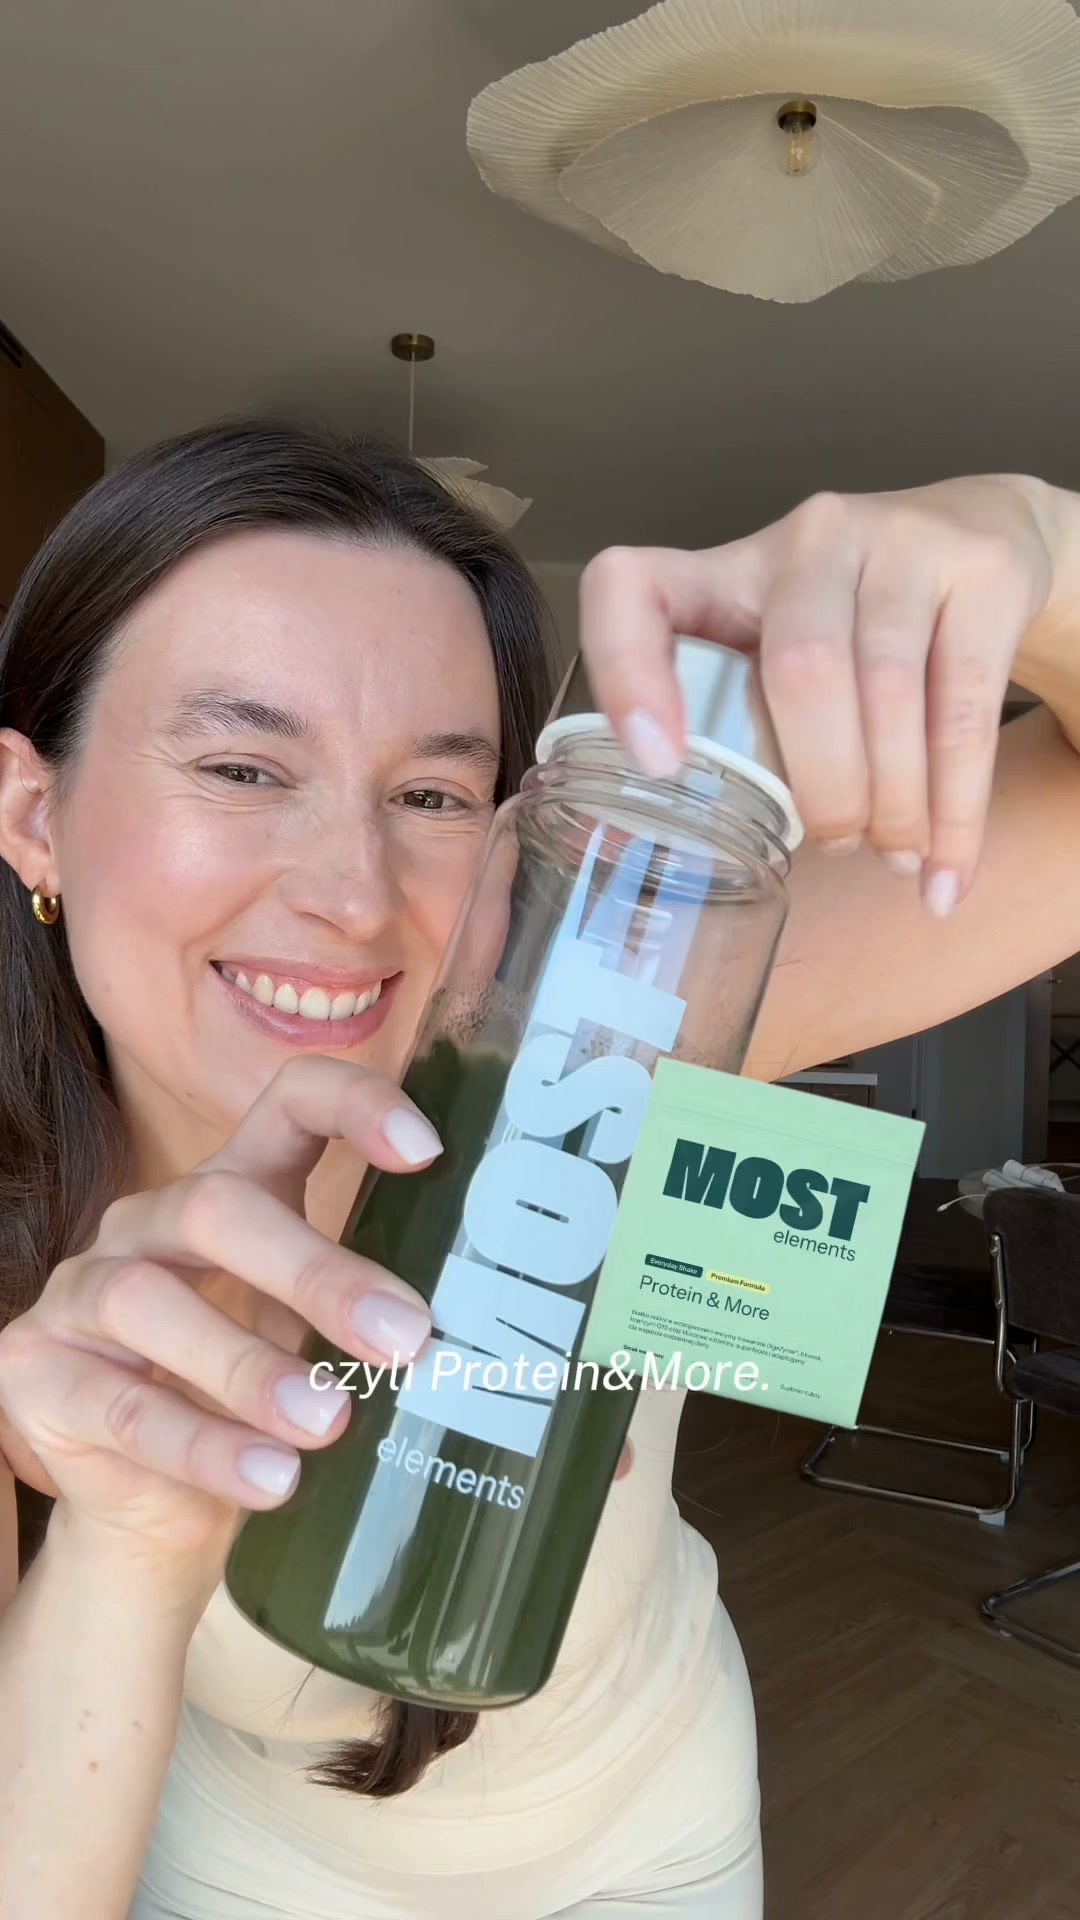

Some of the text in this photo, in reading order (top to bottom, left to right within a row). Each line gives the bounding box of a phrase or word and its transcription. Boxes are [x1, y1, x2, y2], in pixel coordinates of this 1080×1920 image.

[396, 938, 687, 1457] MOST
[663, 1138, 871, 1241] MOST
[773, 1230, 856, 1262] elements
[650, 1257, 698, 1275] Everyday Shake
[710, 1272, 766, 1292] Premium Formula
[639, 1274, 770, 1321] Protein & More
[623, 1344, 638, 1352] Smak
[376, 1433, 525, 1509] elements
